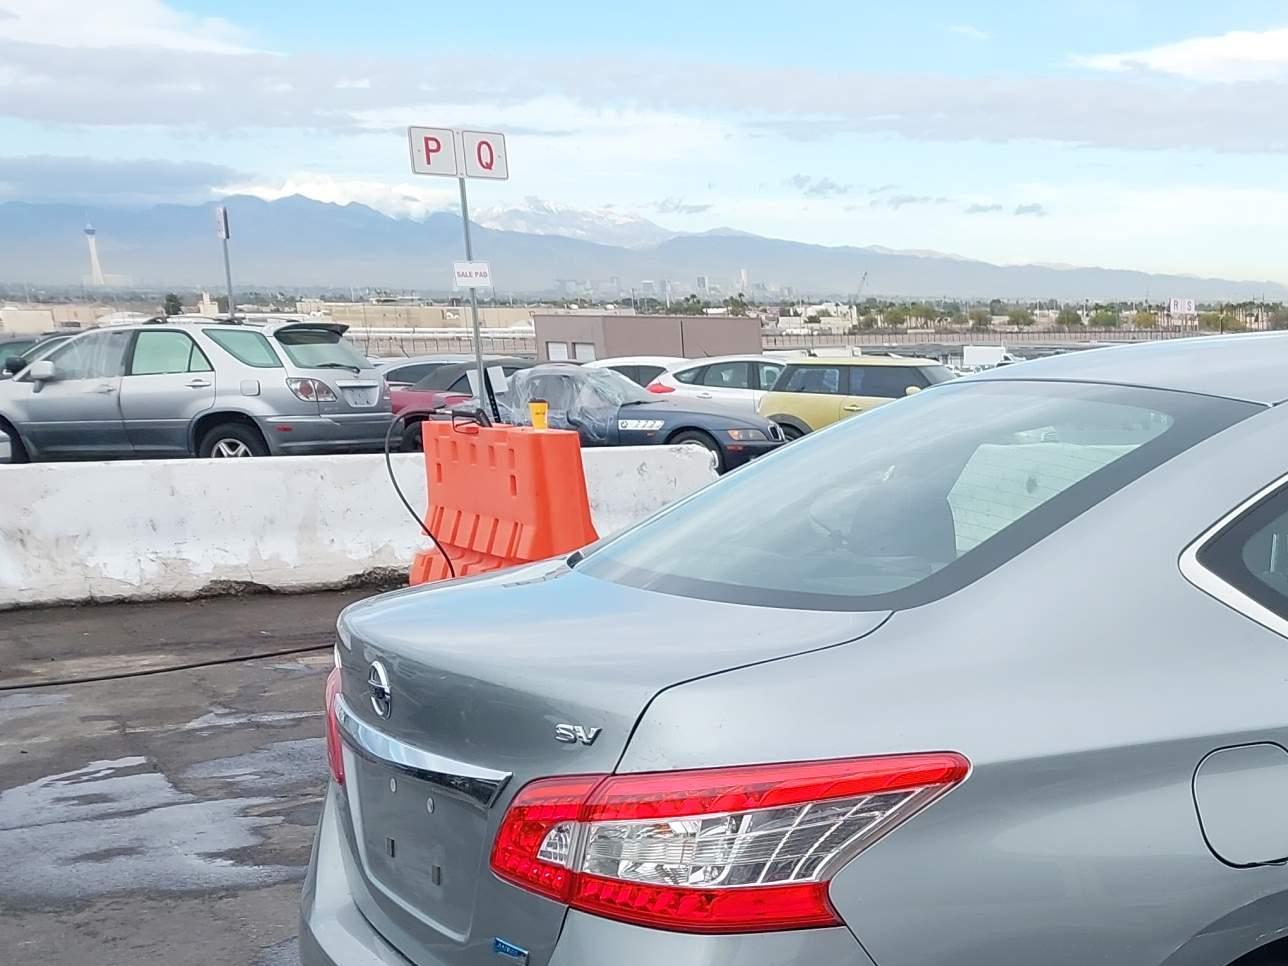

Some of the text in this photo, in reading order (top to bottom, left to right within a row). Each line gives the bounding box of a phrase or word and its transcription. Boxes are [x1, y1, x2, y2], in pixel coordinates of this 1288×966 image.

[423, 136, 442, 166] P
[476, 140, 495, 171] Q
[554, 723, 603, 747] SV
